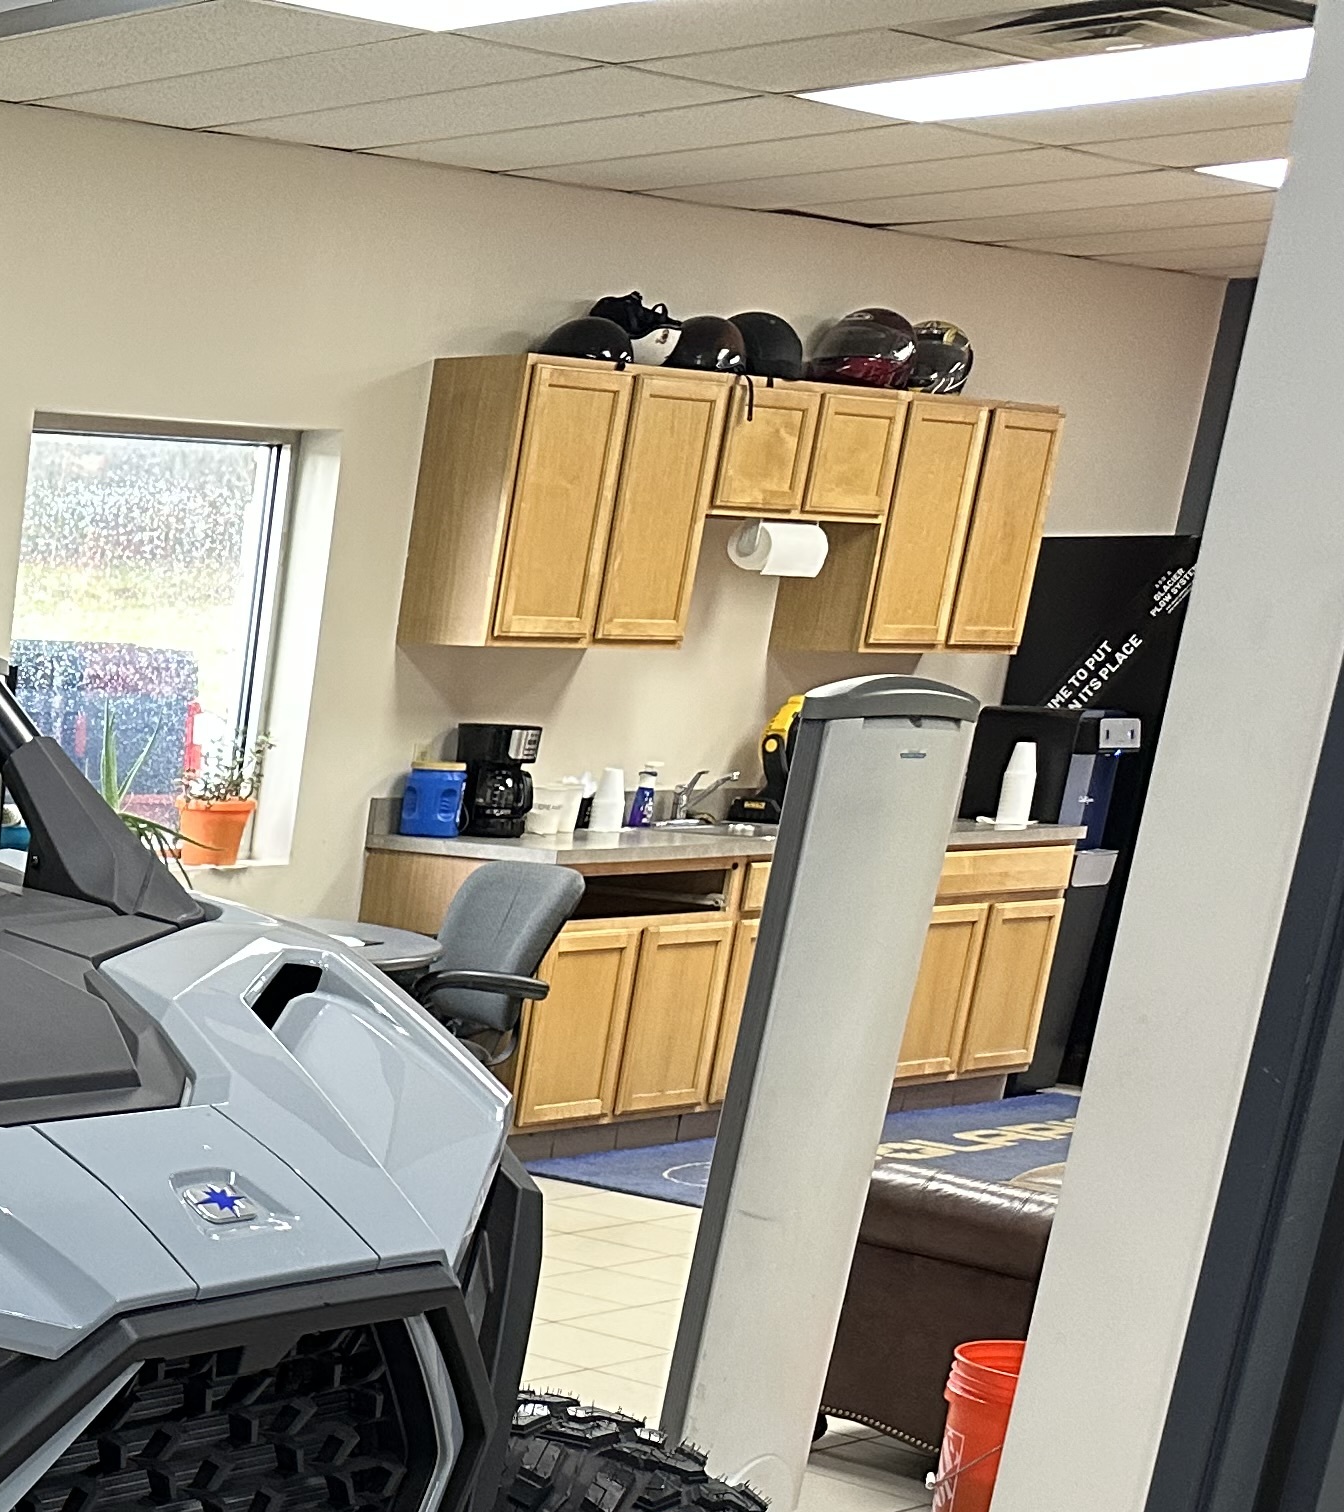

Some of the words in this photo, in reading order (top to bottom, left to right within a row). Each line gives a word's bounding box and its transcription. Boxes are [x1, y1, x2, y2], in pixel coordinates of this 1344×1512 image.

[1149, 593, 1172, 617] PLOW
[1170, 564, 1197, 595] SYSTE
[1153, 567, 1185, 601] GLACIER
[1047, 685, 1073, 709] IME
[1067, 668, 1088, 687] TO
[1084, 640, 1112, 671] PUT
[1077, 677, 1102, 703] ITS
[1098, 633, 1143, 681] PLACE
[875, 1117, 1077, 1160] OLAR
